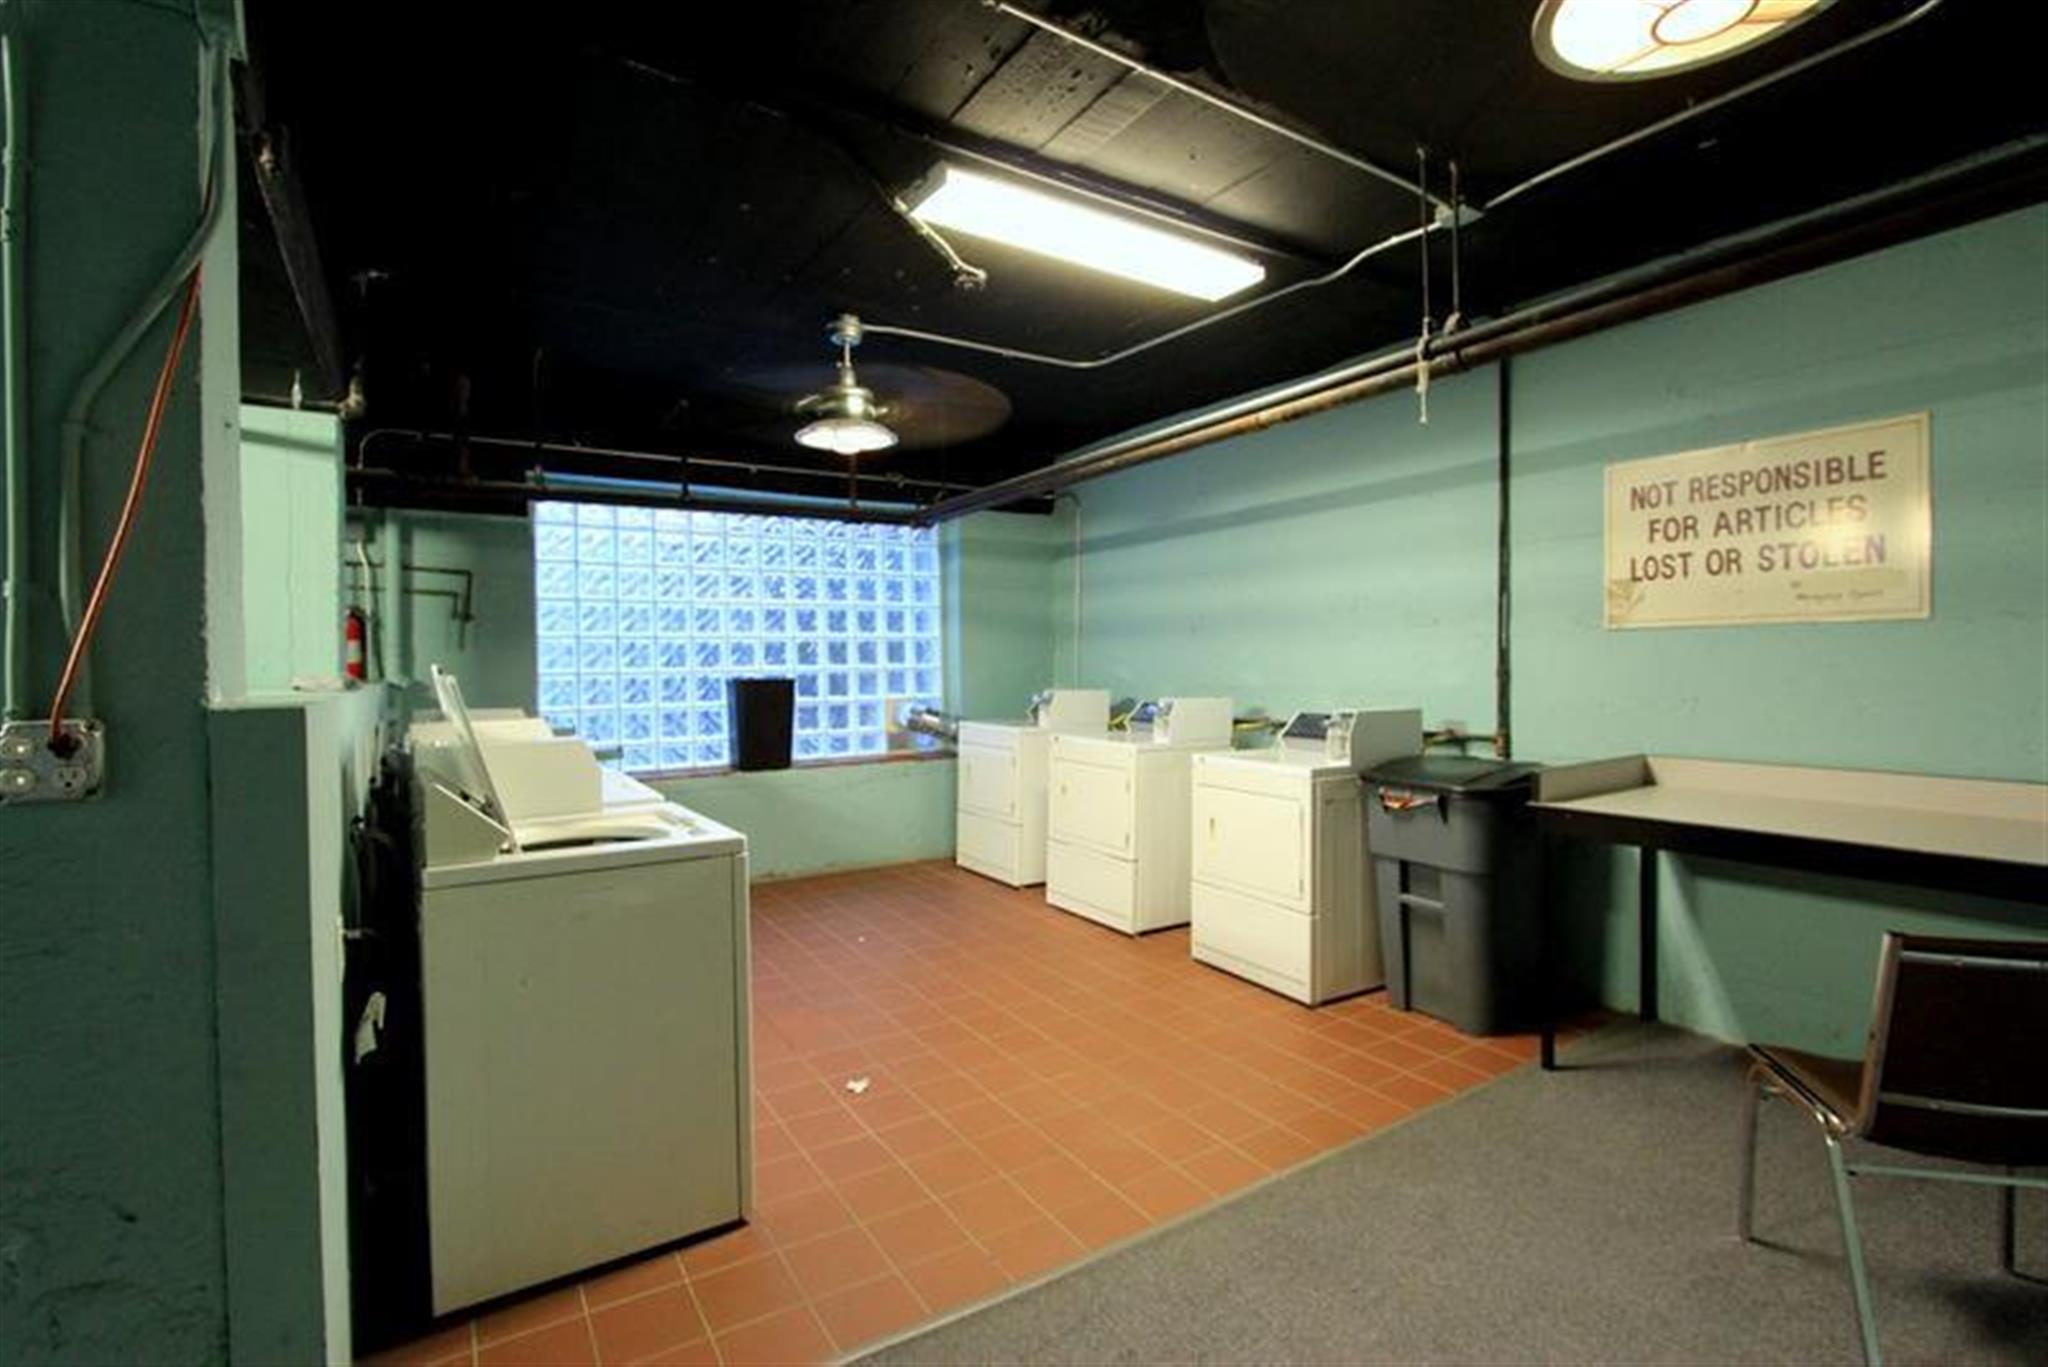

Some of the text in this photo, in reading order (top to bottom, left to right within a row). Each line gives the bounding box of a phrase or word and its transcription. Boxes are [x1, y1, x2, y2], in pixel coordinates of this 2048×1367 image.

[1631, 450, 1887, 511] NOT RESPONSIBLE
[1648, 494, 1869, 544] FOR ARTICLES
[1630, 534, 1887, 583] LOST OR STOLEN
